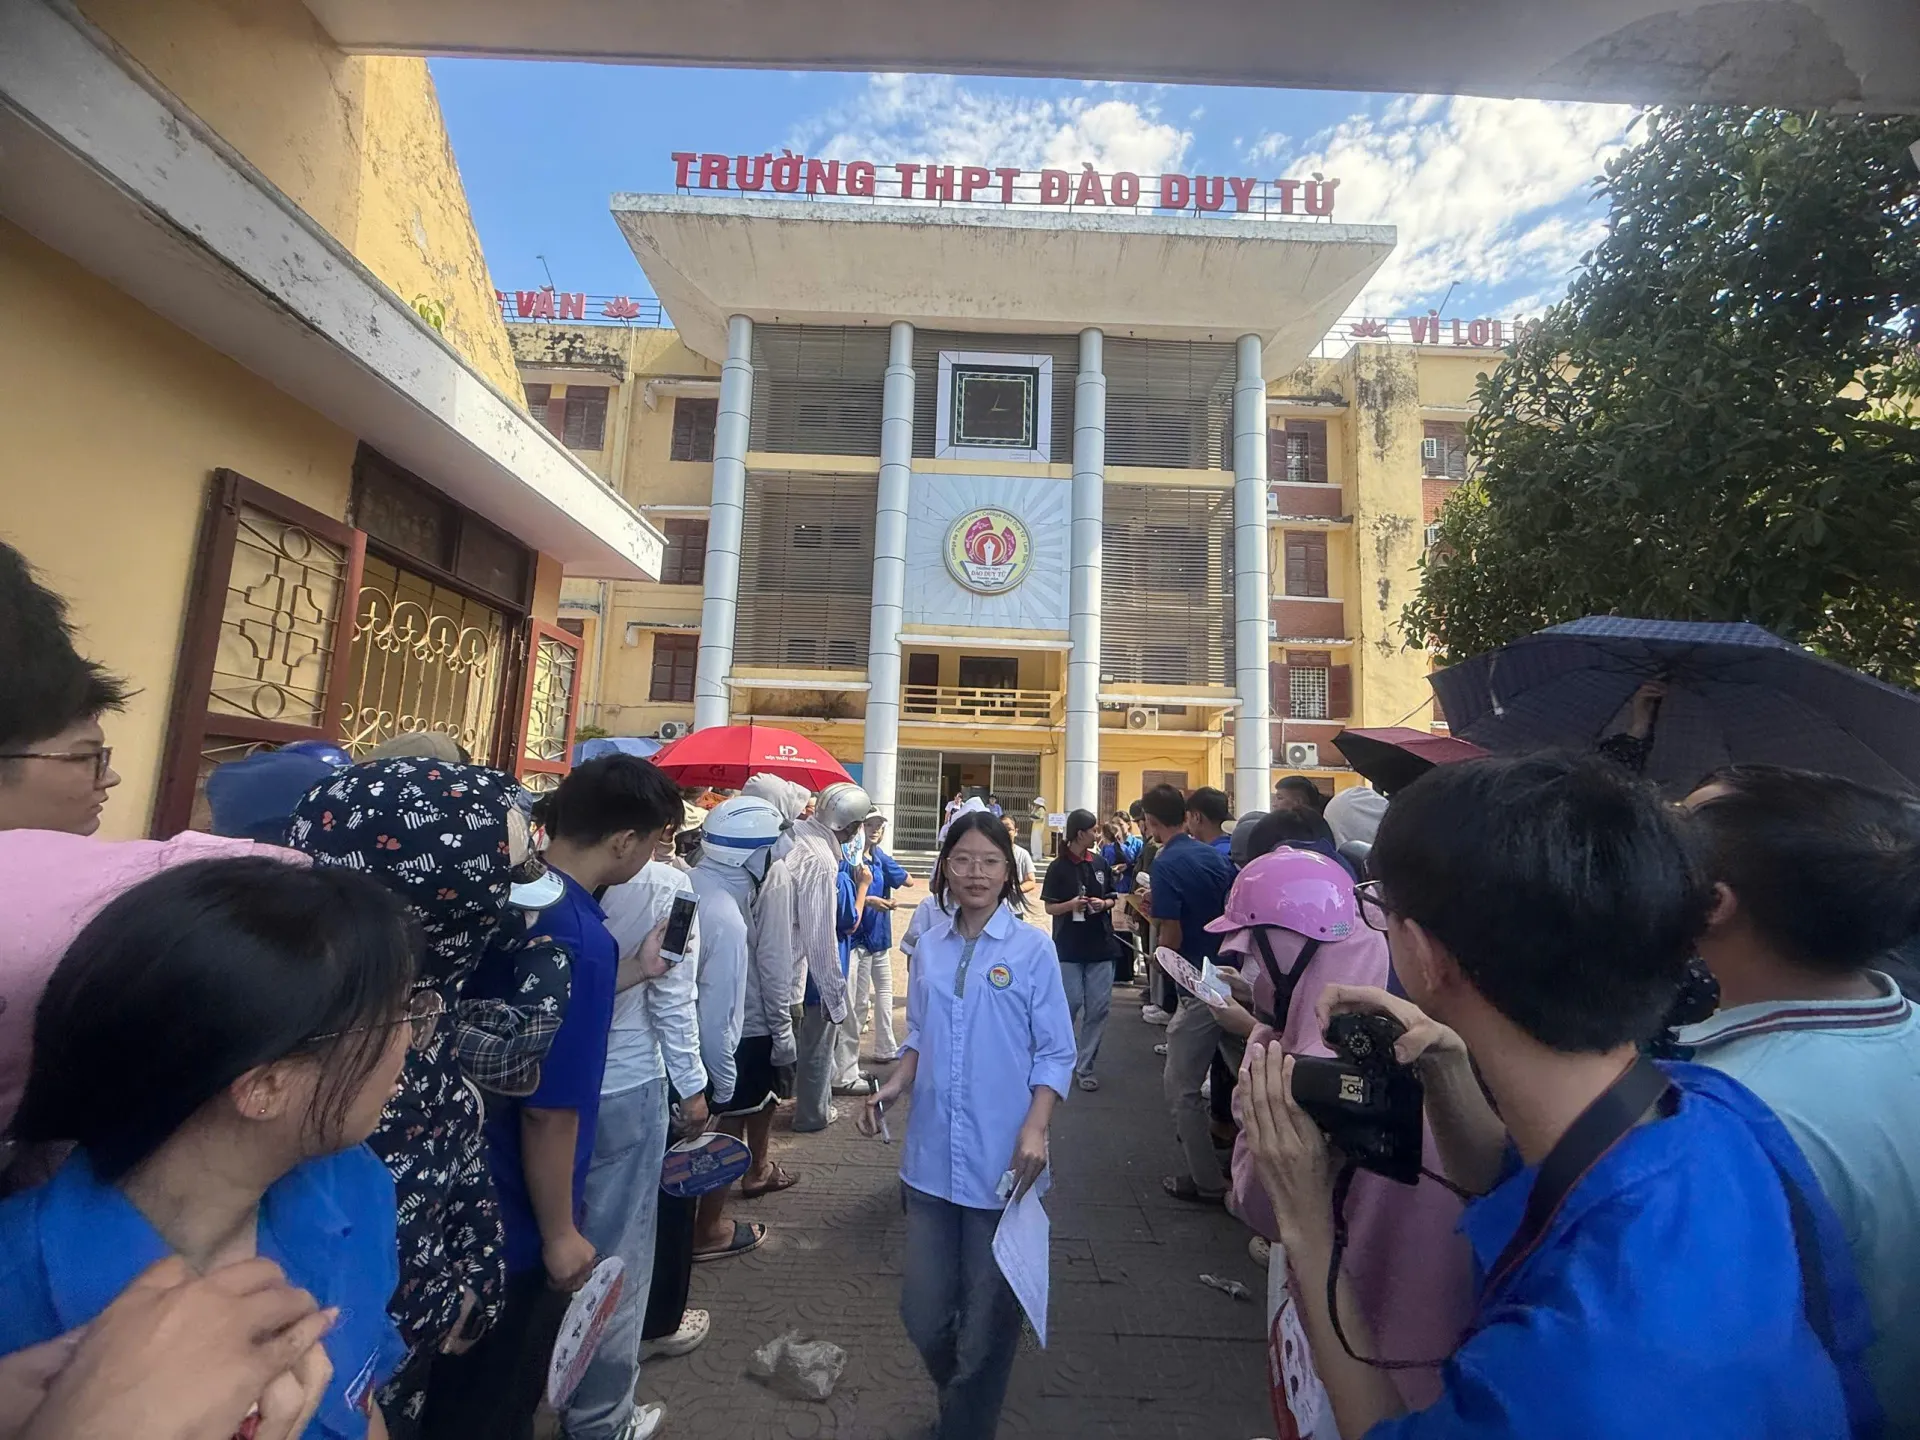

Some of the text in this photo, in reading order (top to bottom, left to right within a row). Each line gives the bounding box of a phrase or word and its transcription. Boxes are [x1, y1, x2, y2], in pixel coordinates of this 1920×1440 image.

[671, 148, 1341, 216] TRƯỜNG THPT ĐÀO DUY TỪ
[516, 286, 587, 321] VĂN
[1408, 309, 1439, 344] VÌ
[404, 811, 442, 830] Mine
